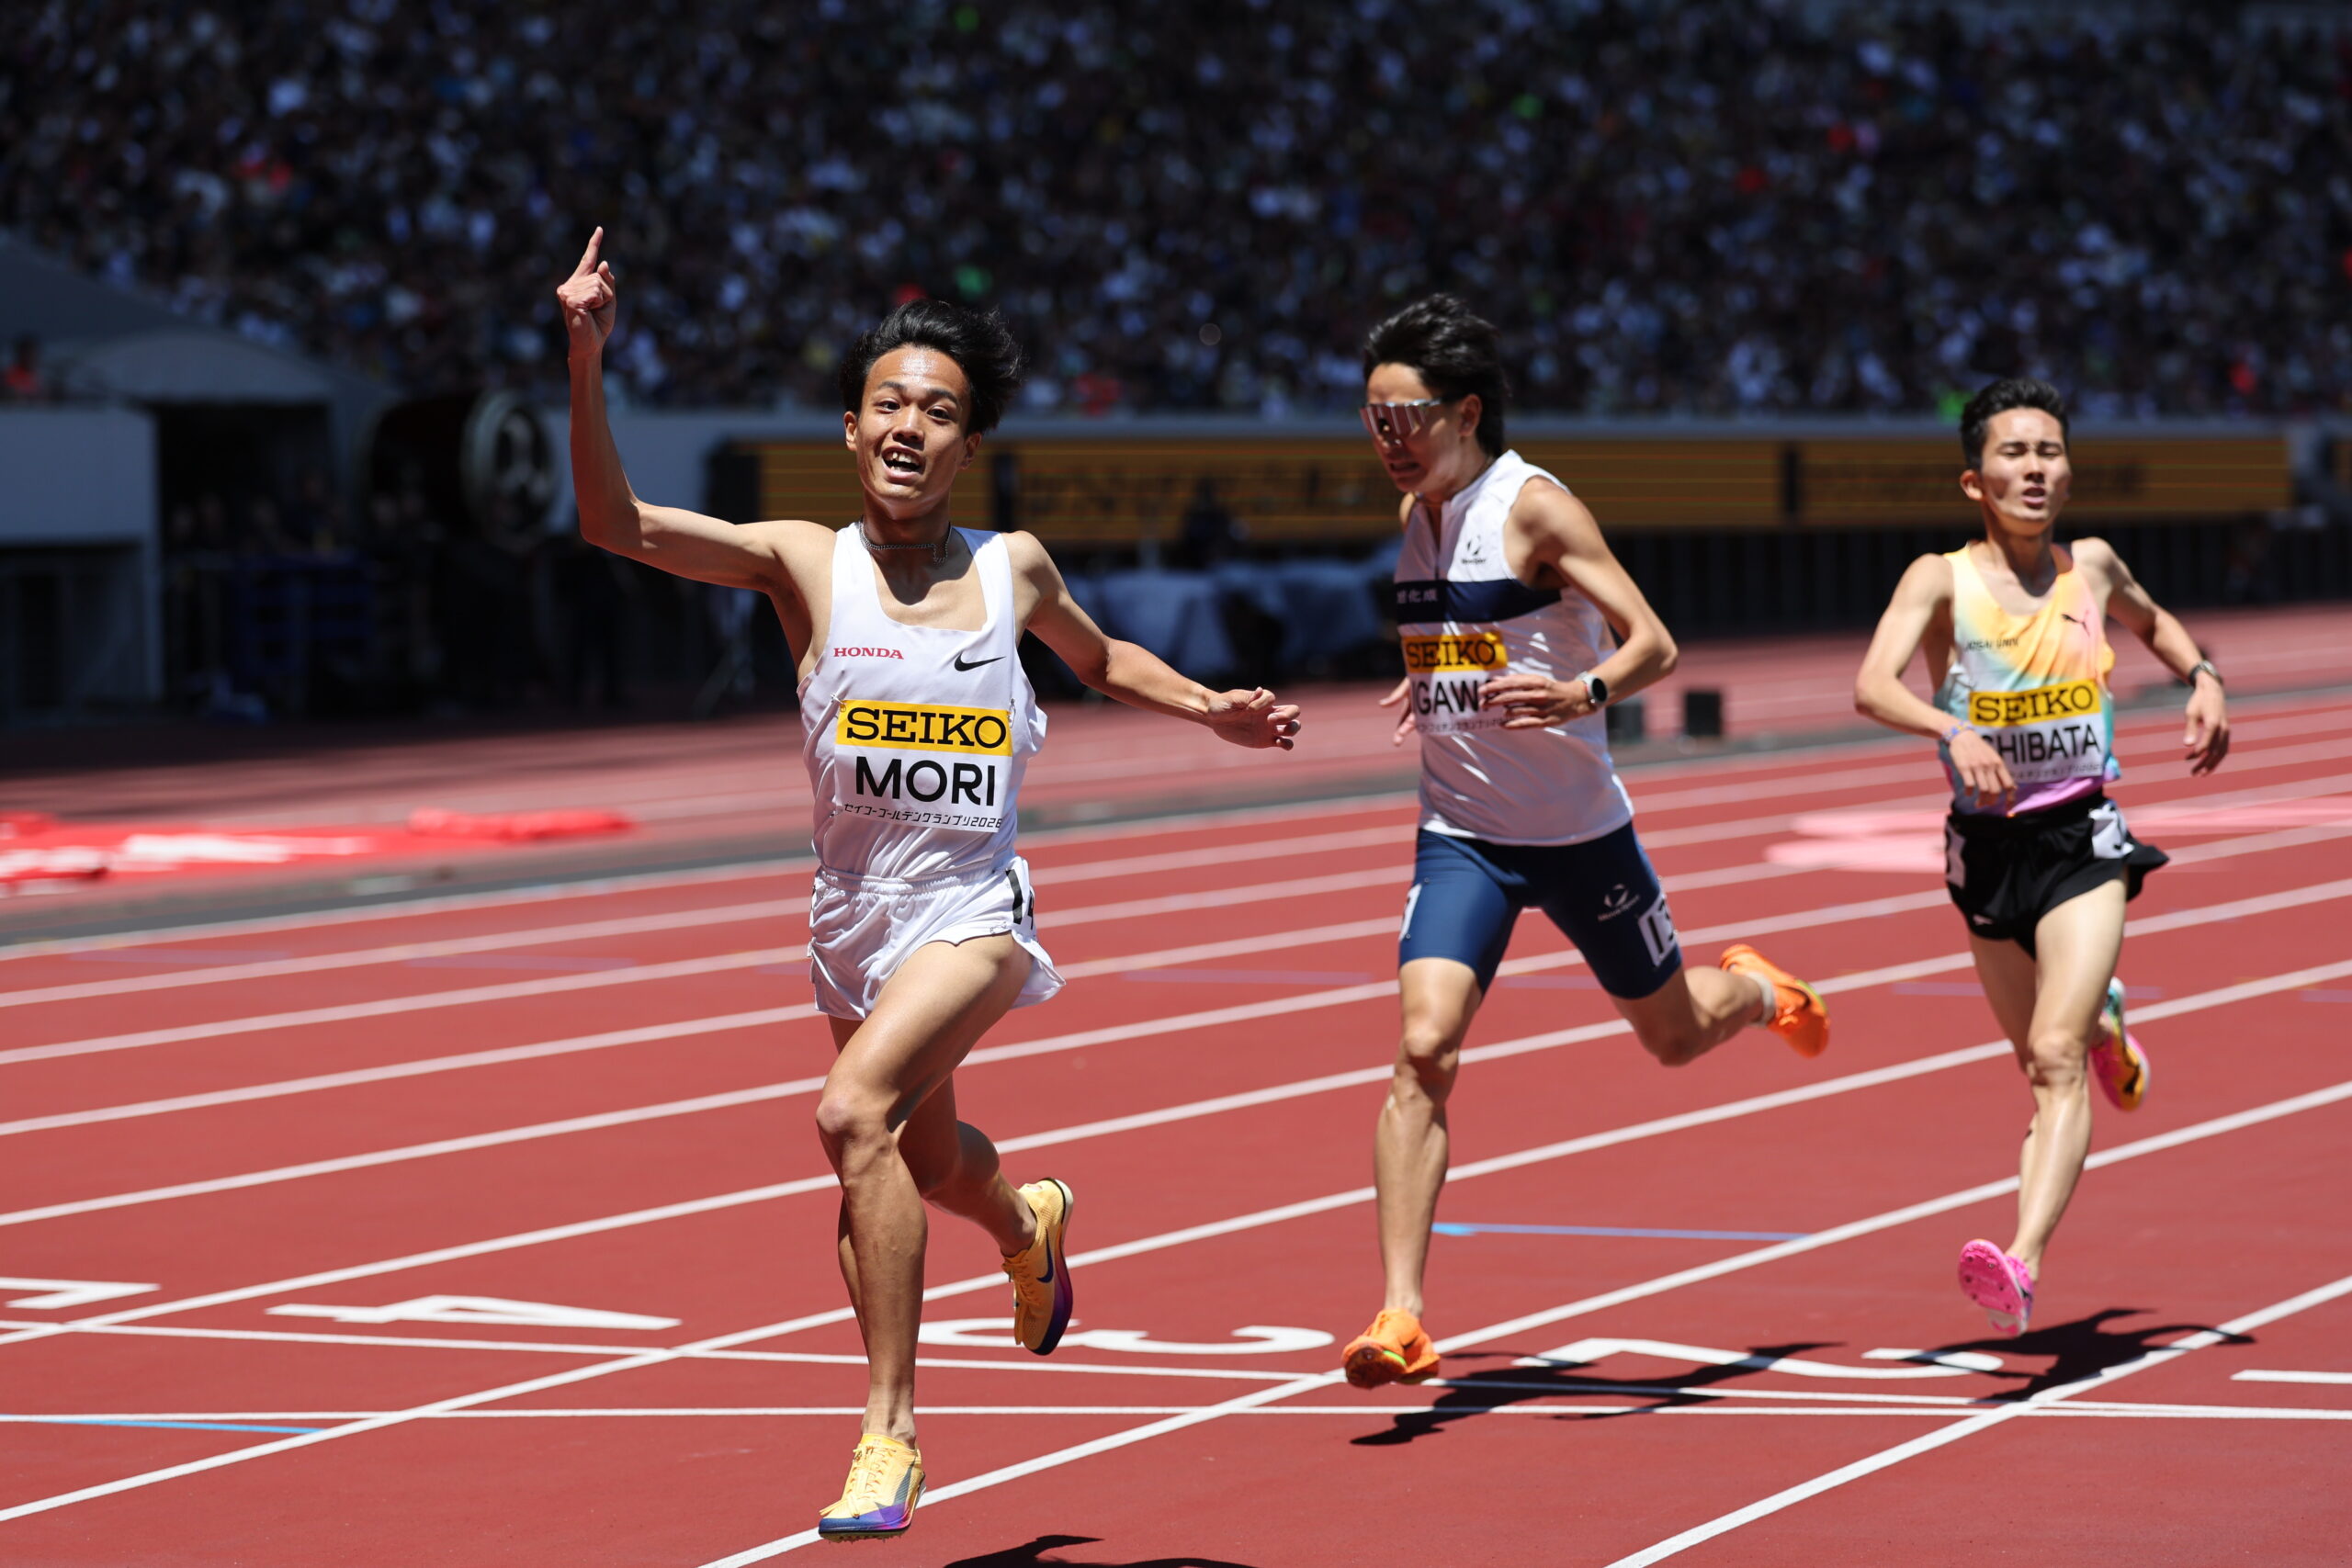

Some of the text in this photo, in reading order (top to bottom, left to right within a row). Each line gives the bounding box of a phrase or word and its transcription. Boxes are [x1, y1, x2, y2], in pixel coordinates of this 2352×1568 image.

[833, 647, 904, 660] HONDA
[1407, 638, 1497, 668] SEIKO
[1975, 684, 2094, 723] SEIKO
[846, 706, 1008, 750] SEIKO
[855, 755, 996, 807] MORI
